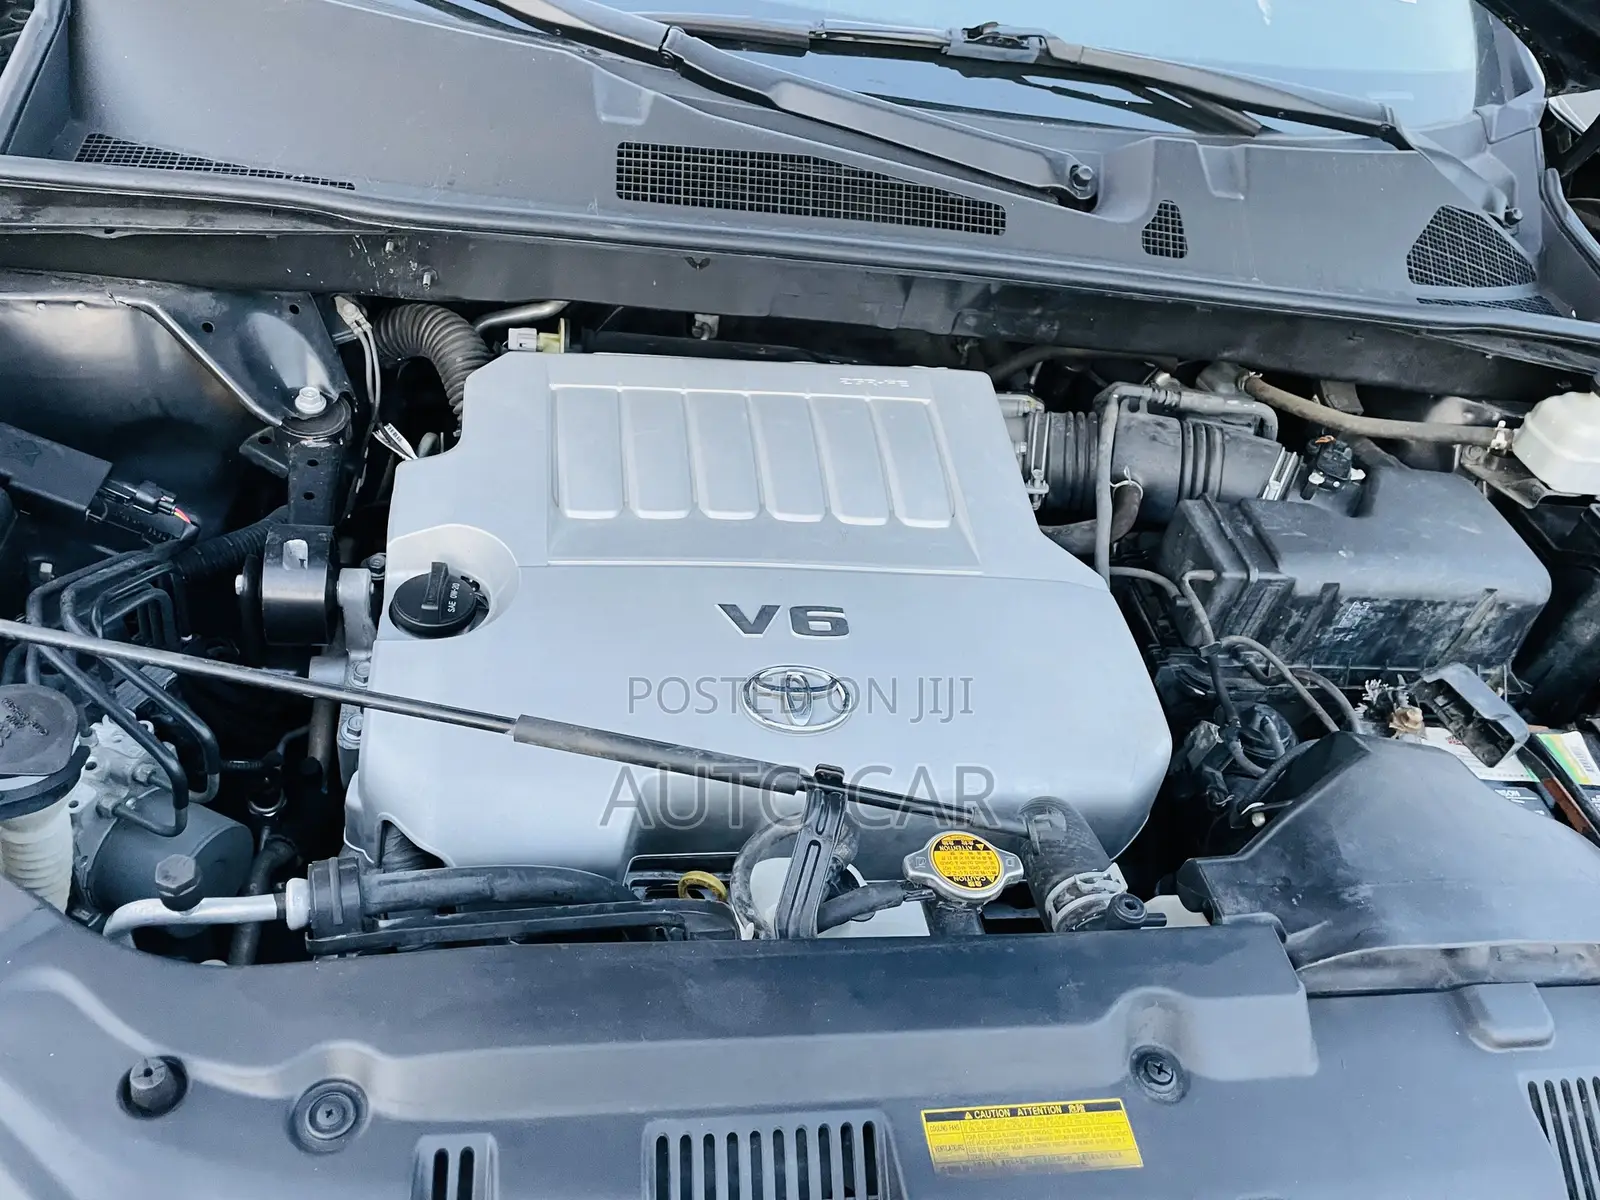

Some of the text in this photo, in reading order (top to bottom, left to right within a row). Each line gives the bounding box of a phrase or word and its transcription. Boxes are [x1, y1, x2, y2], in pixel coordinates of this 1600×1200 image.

[447, 601, 457, 613] SAE
[716, 603, 850, 638] V6
[974, 1108, 1011, 1120] CAUTION
[1017, 1104, 1063, 1117] ATTENTION
